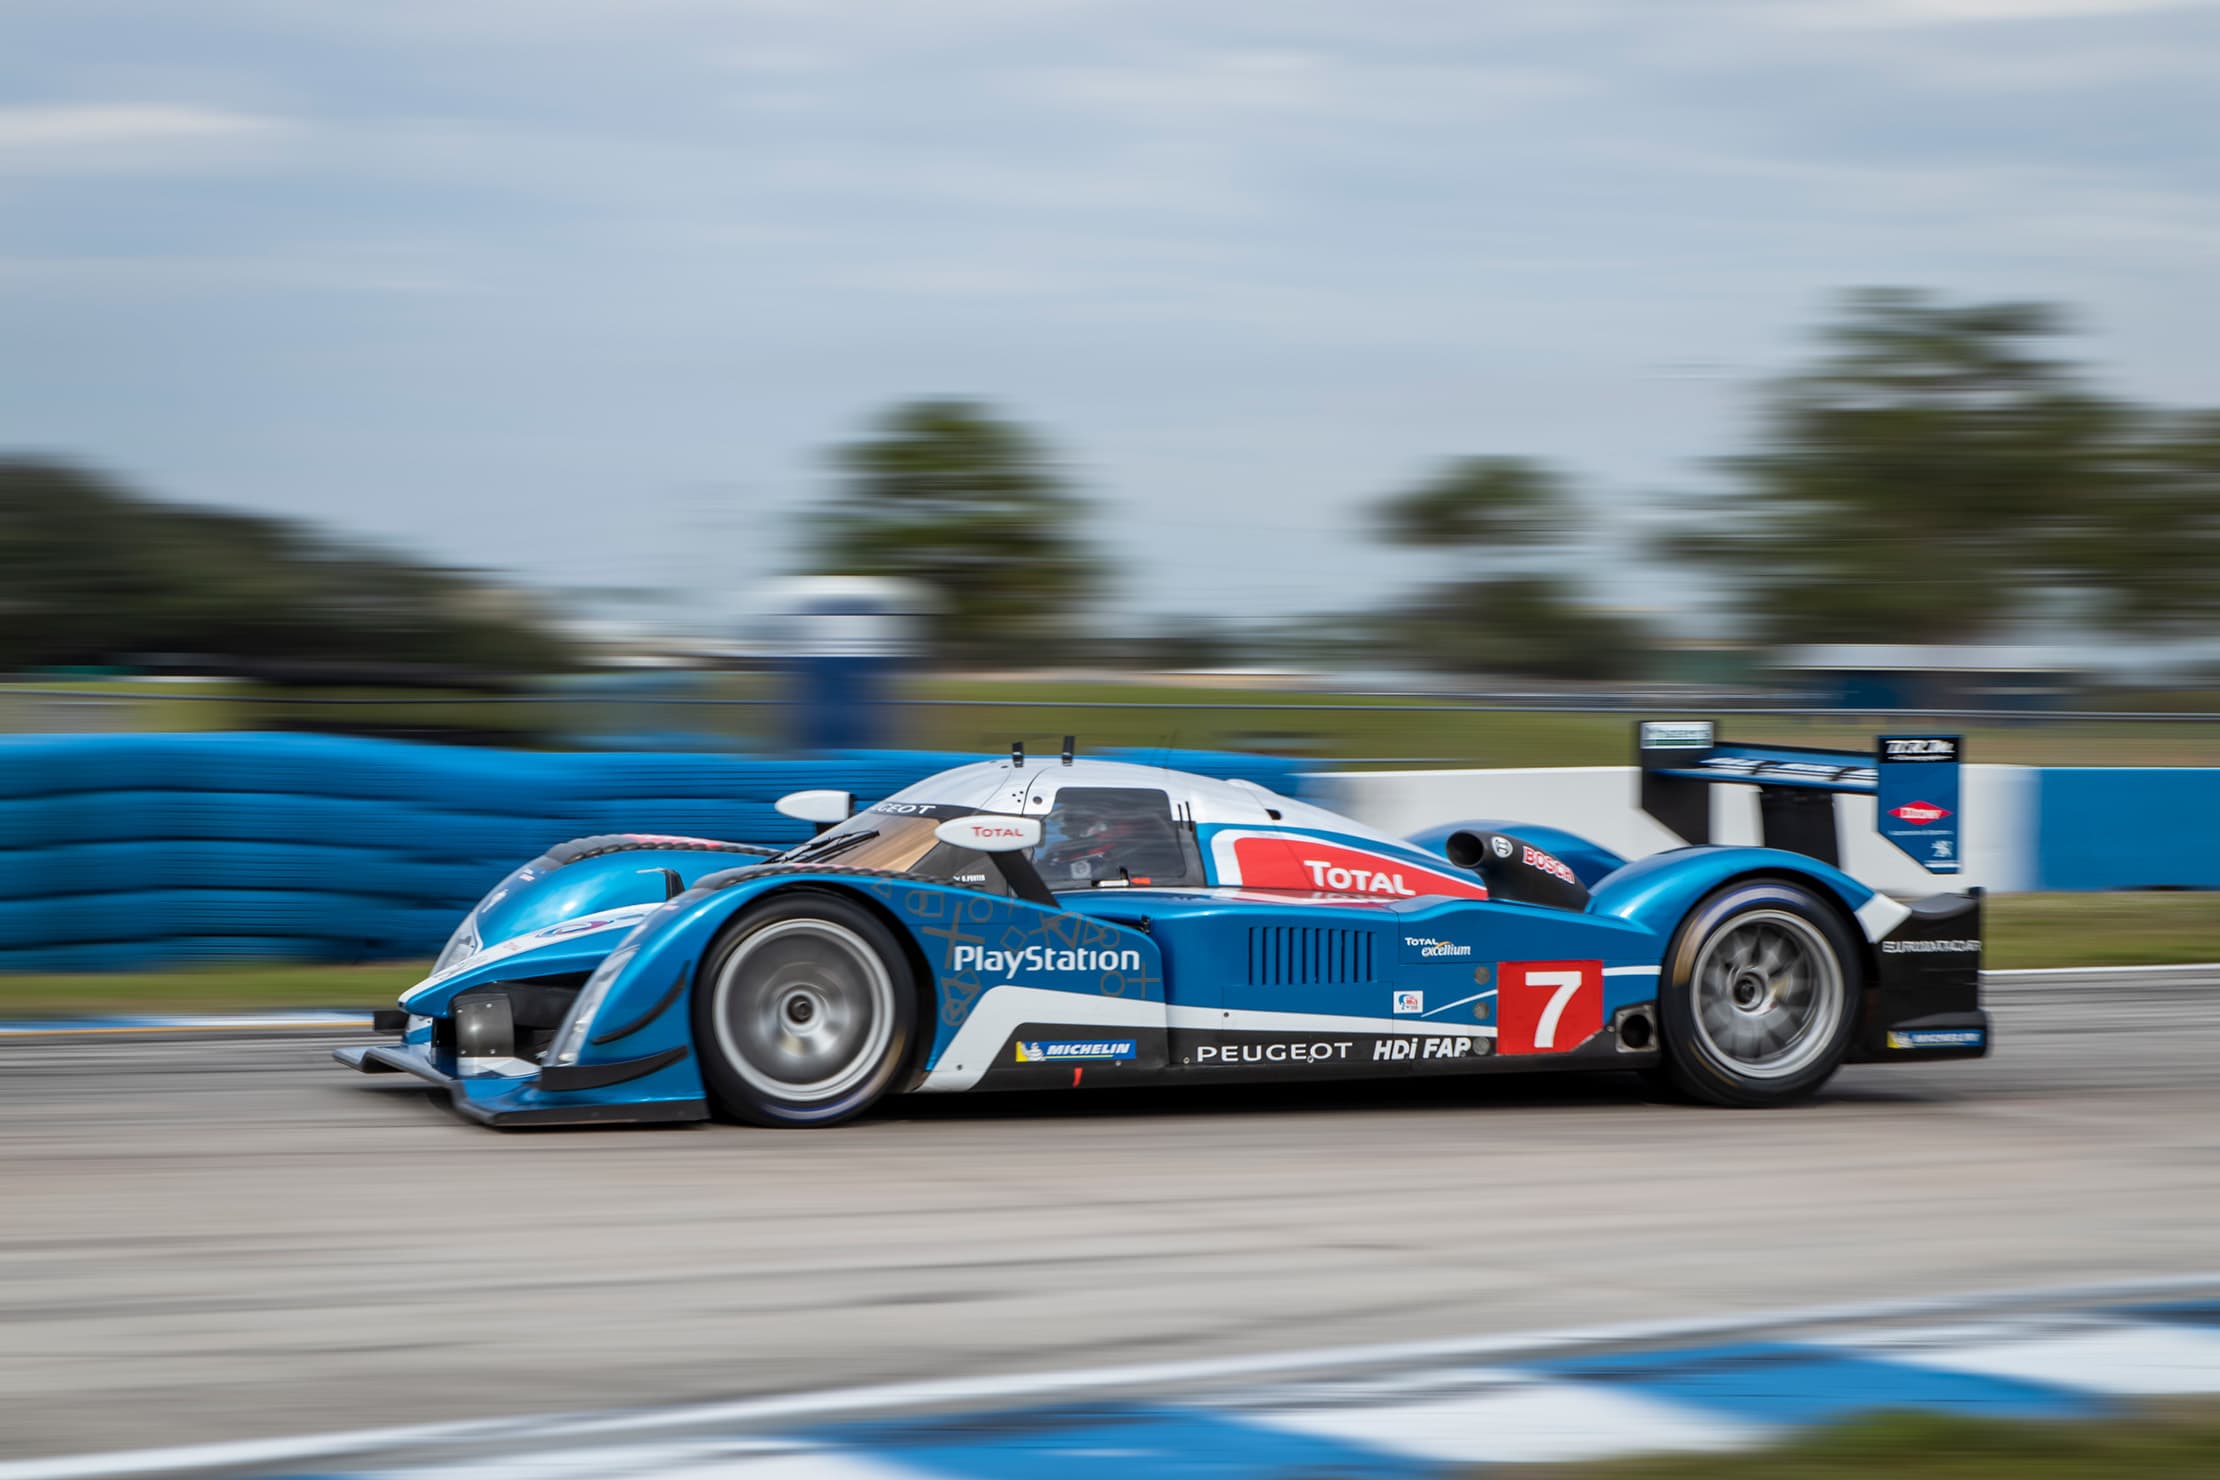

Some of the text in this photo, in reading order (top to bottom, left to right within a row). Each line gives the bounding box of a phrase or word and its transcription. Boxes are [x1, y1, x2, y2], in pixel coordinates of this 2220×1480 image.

[970, 826, 1024, 838] TOTAL
[1522, 845, 1576, 885] BOSCH
[1303, 860, 1417, 896] TOTAL
[1404, 936, 1439, 946] TOTAL
[1421, 943, 1472, 958] excellium
[954, 945, 1141, 980] PlayStation
[1524, 970, 1583, 1049] 7
[1046, 1043, 1131, 1056] MICHELIN
[1196, 1042, 1354, 1063] PEUGEOT
[1373, 1037, 1472, 1061] HDi FAP
